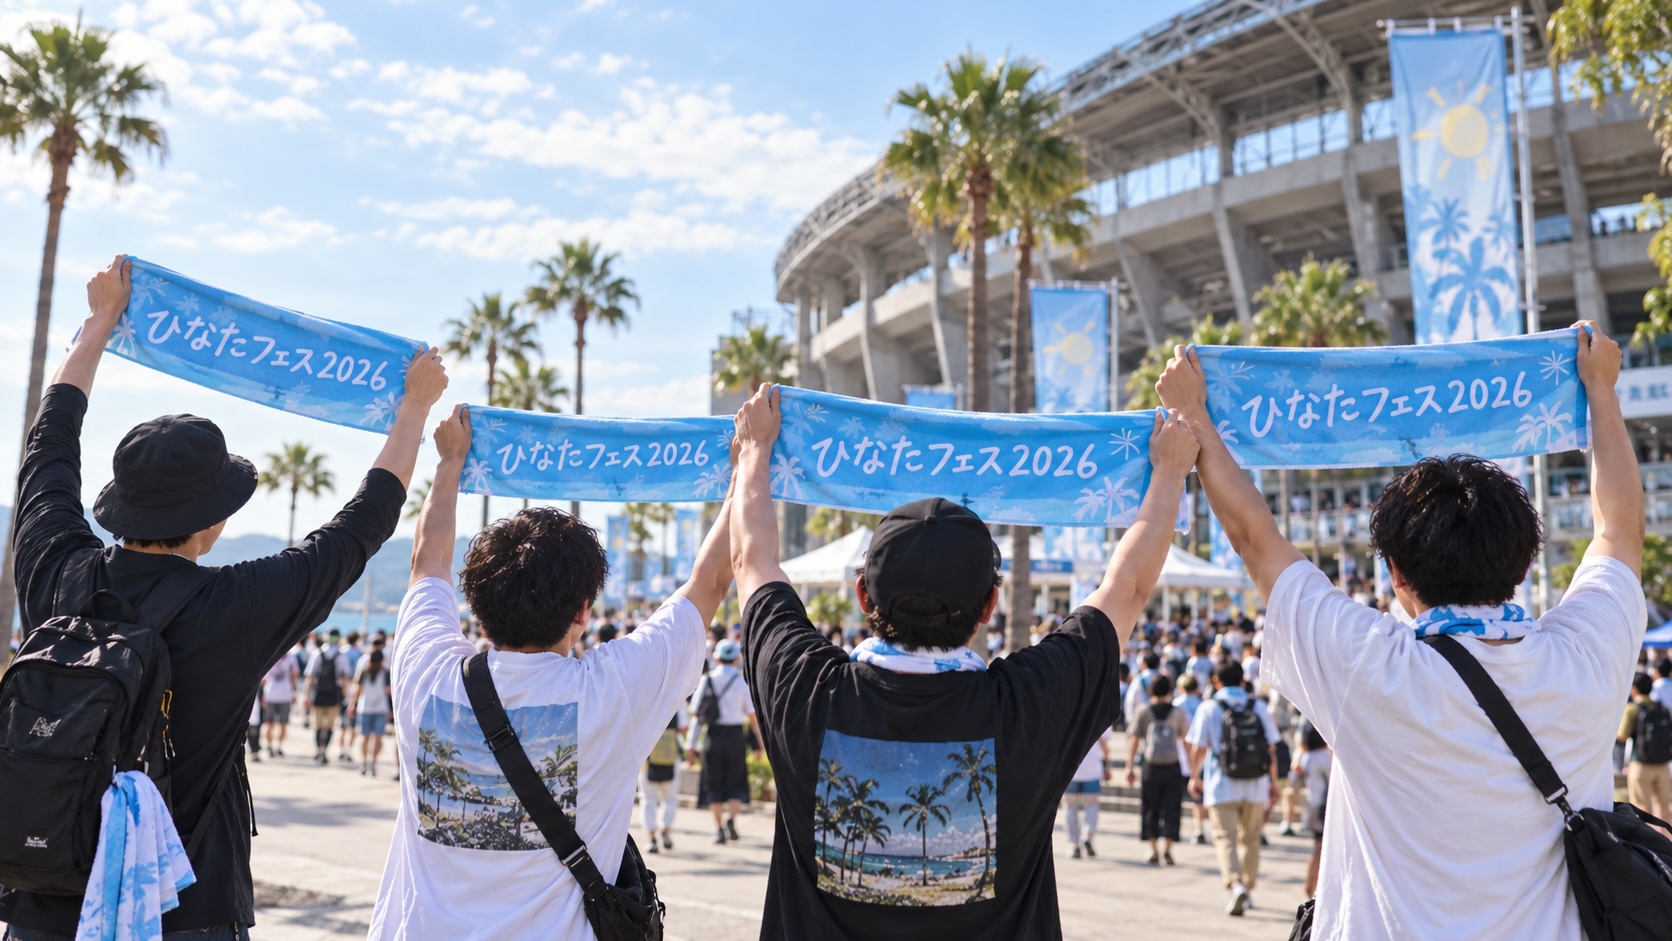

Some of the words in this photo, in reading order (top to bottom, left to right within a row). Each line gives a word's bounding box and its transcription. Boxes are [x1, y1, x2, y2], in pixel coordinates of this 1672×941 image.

[147, 310, 388, 390] ひなたフェス2026
[1241, 371, 1532, 438] ひなたフェス2026
[496, 438, 709, 475] ひなたフェス2026
[811, 435, 1097, 479] ひなたフェス2026
